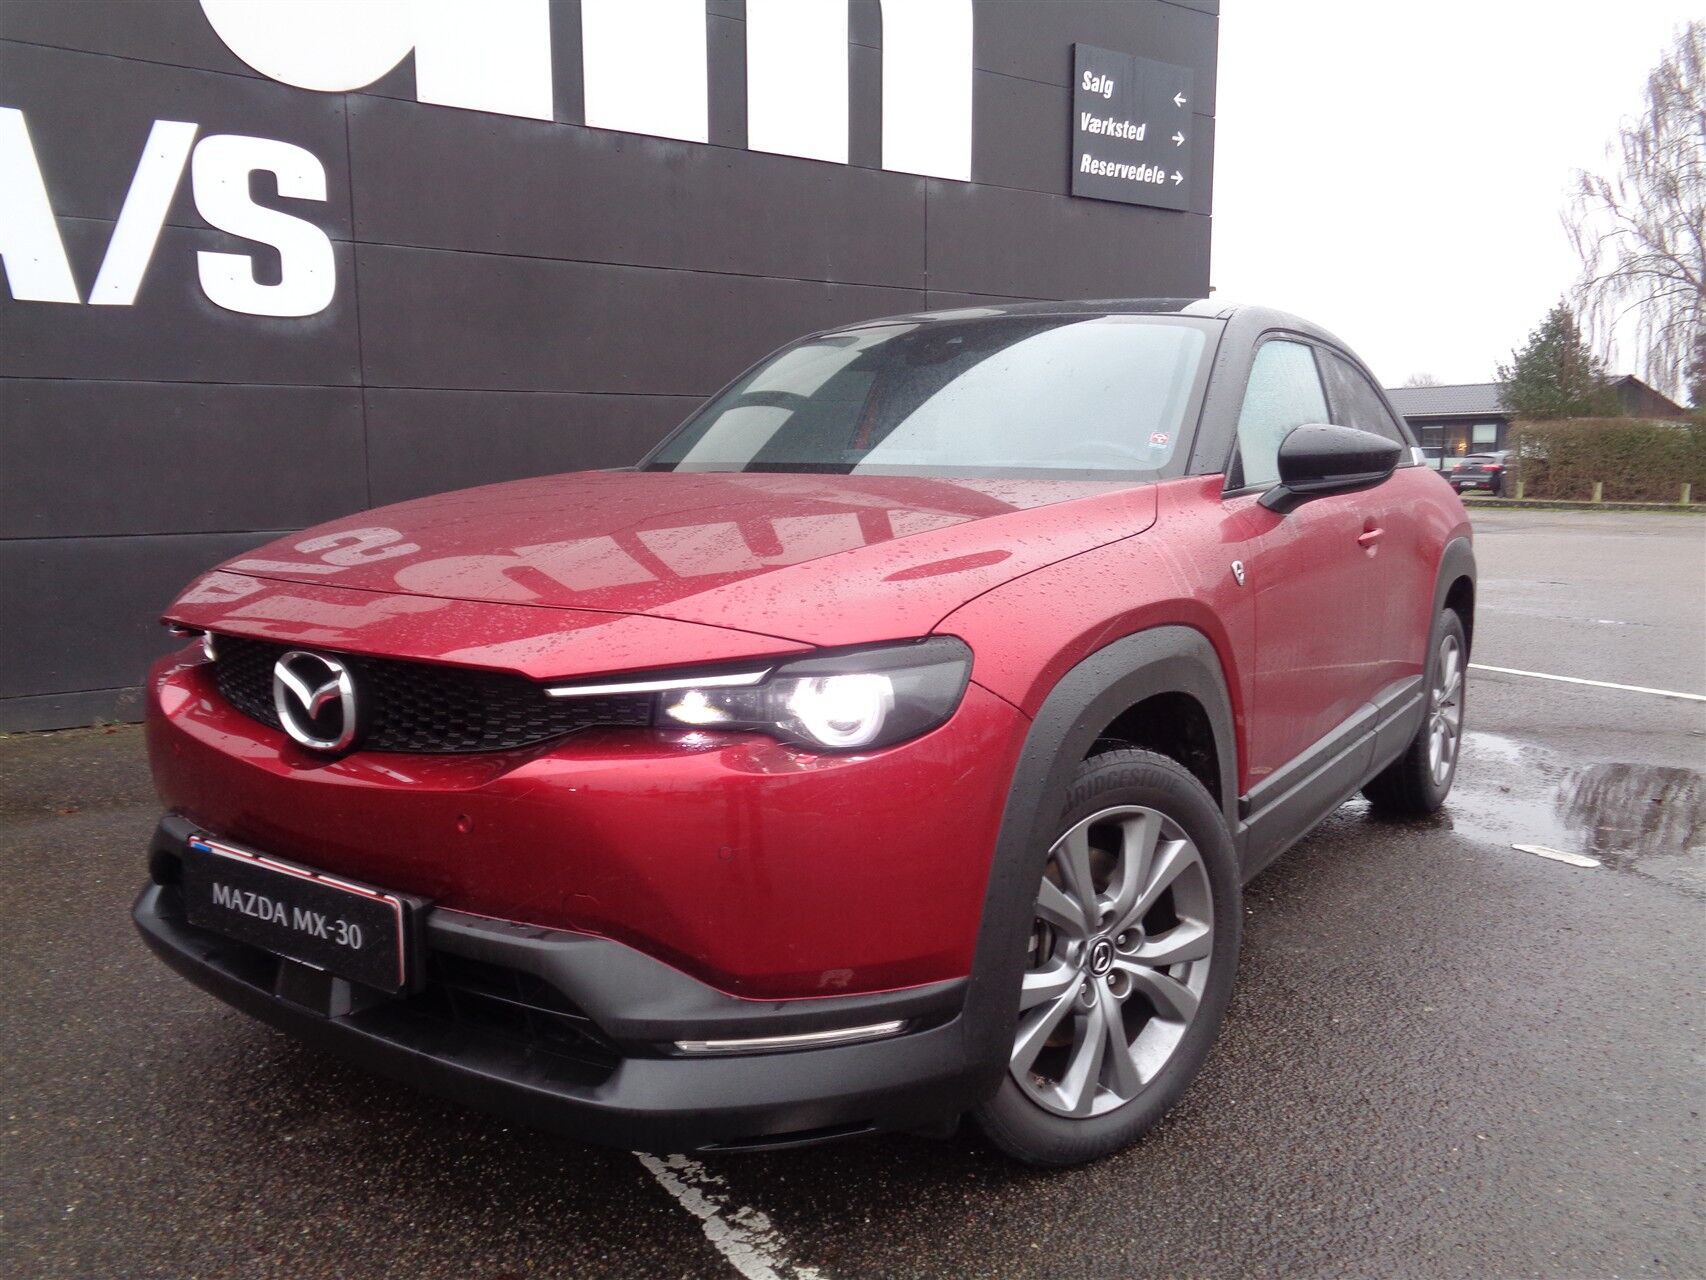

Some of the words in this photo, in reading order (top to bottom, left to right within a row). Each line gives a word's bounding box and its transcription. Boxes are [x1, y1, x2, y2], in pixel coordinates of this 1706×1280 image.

[1081, 70, 1114, 99] Salg
[1081, 111, 1147, 142] Værksted
[1080, 153, 1166, 185] Reservedele
[212, 882, 289, 927] MAZDA
[292, 907, 363, 950] MX-30
